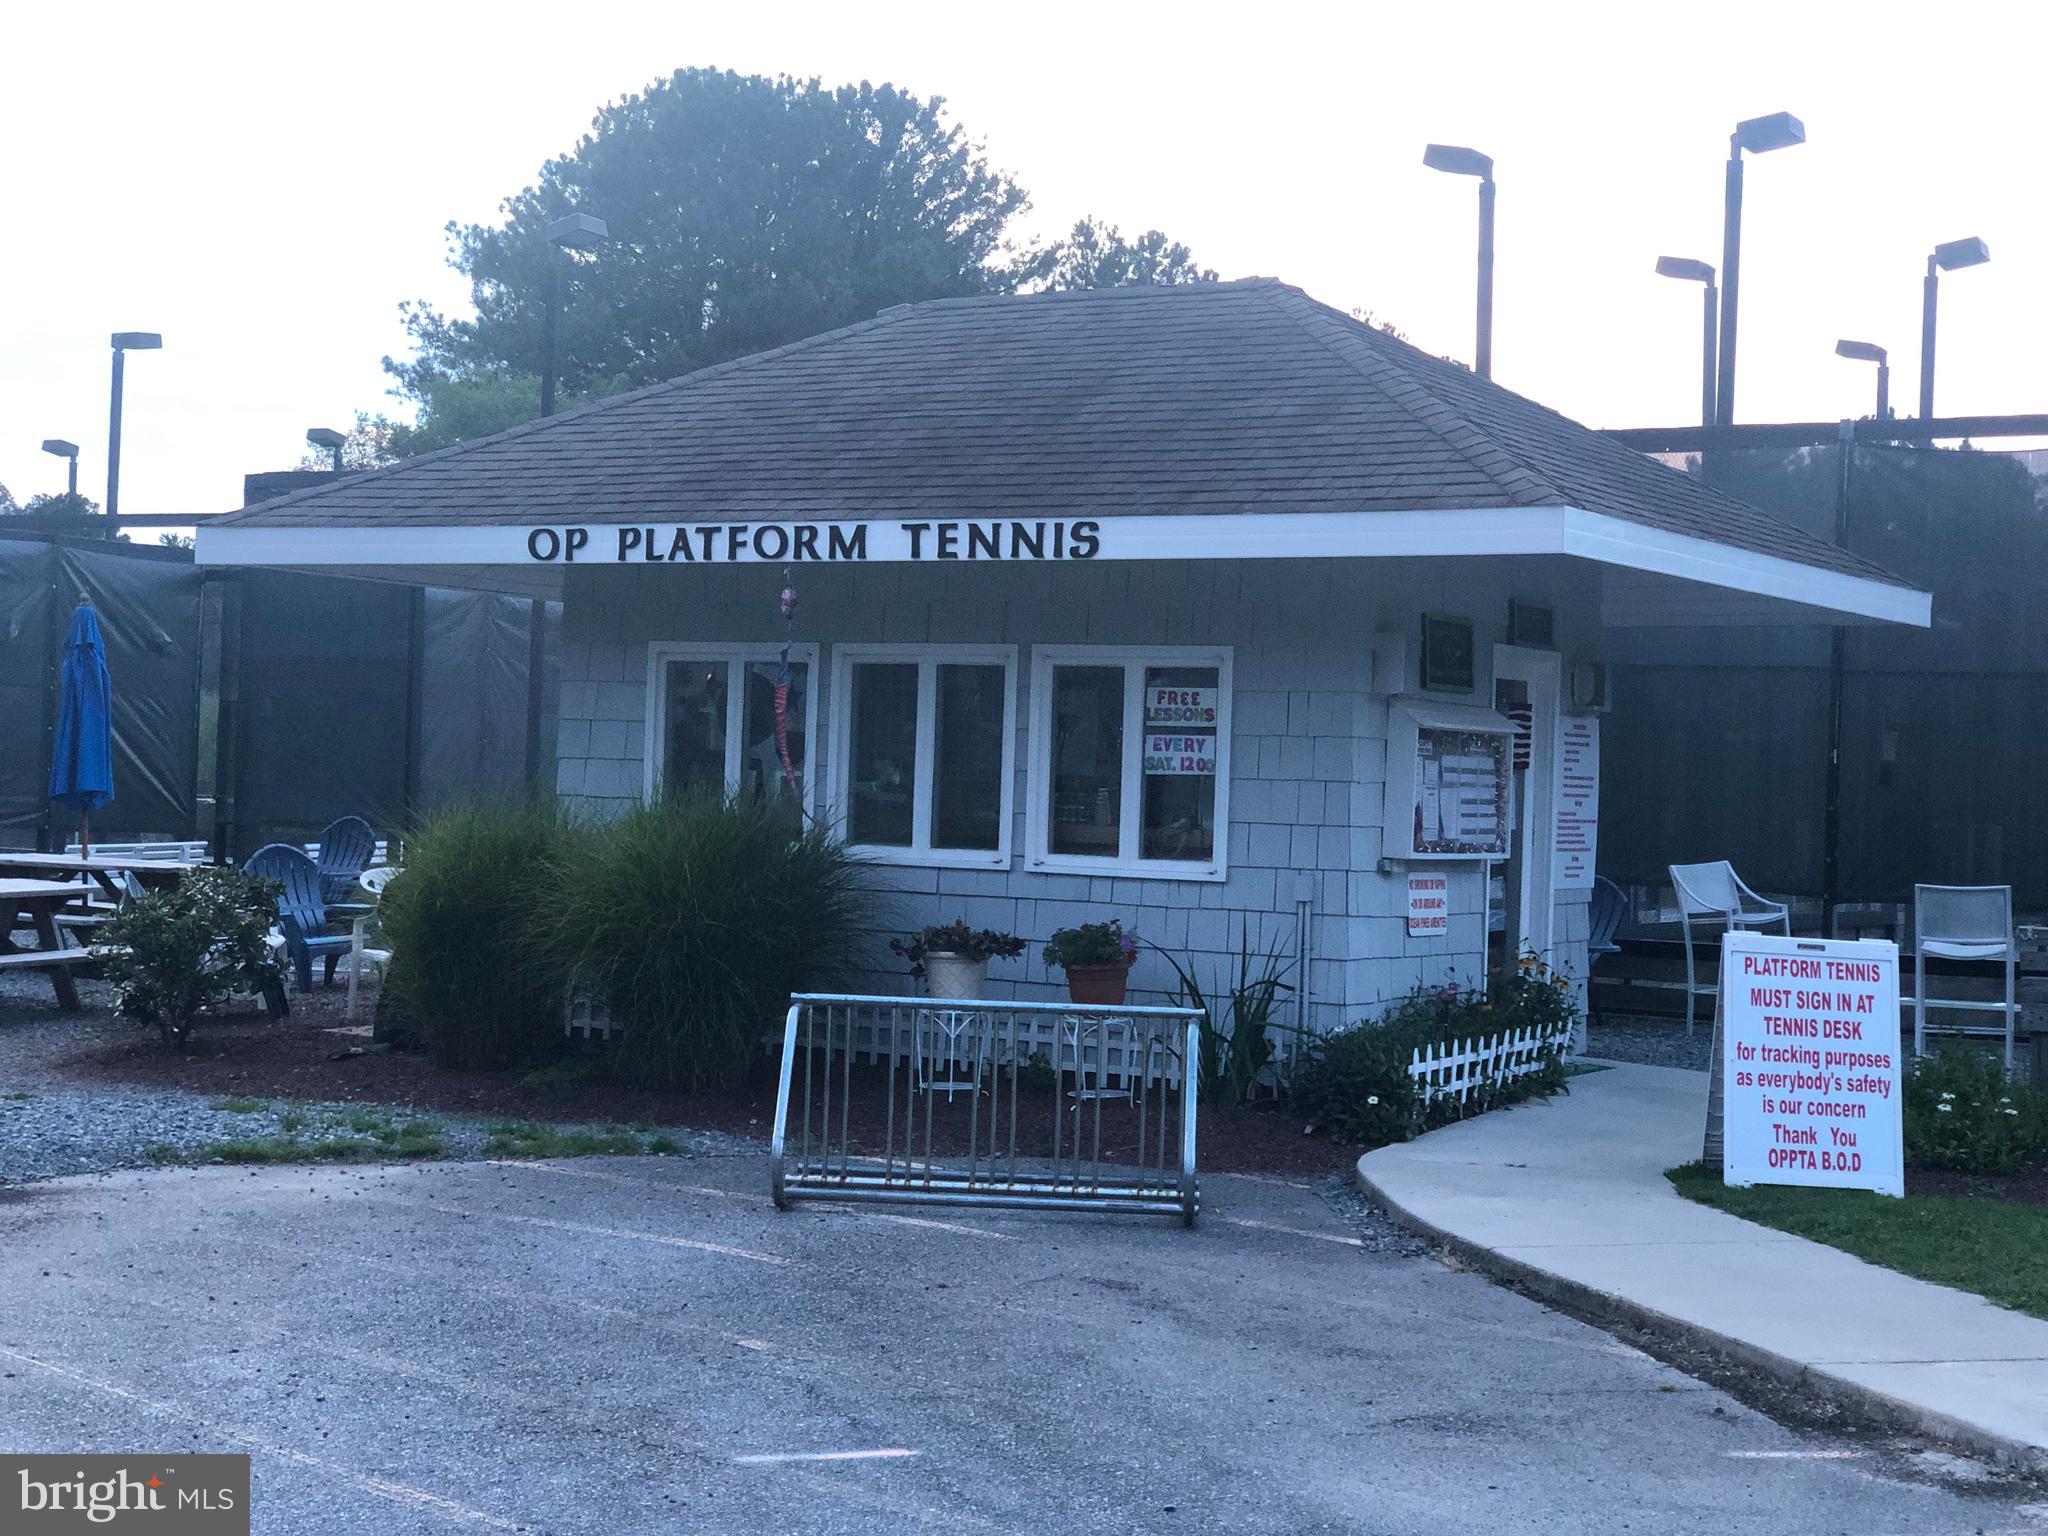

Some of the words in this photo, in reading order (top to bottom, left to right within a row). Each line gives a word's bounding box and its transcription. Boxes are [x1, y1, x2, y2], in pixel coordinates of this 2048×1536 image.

[527, 527, 588, 561] OP
[617, 523, 868, 561] PLATFORM
[901, 520, 1101, 560] TENNIS
[1156, 690, 1200, 706] FREE
[1145, 706, 1215, 722] LESSONS
[1152, 736, 1206, 753] EVERY
[1145, 755, 1176, 771] SAT.
[1744, 956, 1821, 979] PLATFORM
[1826, 962, 1880, 982] TENNIS
[1750, 988, 1791, 1009] MUST
[1796, 990, 1831, 1011] SIGN
[1837, 993, 1851, 1012] IN
[1857, 994, 1875, 1013] AT
[1764, 1016, 1818, 1038] TENNIS
[1823, 1019, 1862, 1040] DESK
[1736, 1041, 1756, 1060] for
[1761, 1045, 1820, 1069] tracking
[1825, 1050, 1890, 1071] purposes
[1736, 1071, 1753, 1086] as
[1758, 1070, 1841, 1095] everybody's
[1847, 1074, 1891, 1099] safety
[1762, 1094, 1775, 1113] is
[1779, 1098, 1802, 1115] our
[1807, 1101, 1866, 1118] concern
[1773, 1124, 1817, 1145] Thank
[1830, 1127, 1857, 1147] You
[1768, 1149, 1817, 1170] OPPTA
[1822, 1151, 1862, 1172] B.O.D
